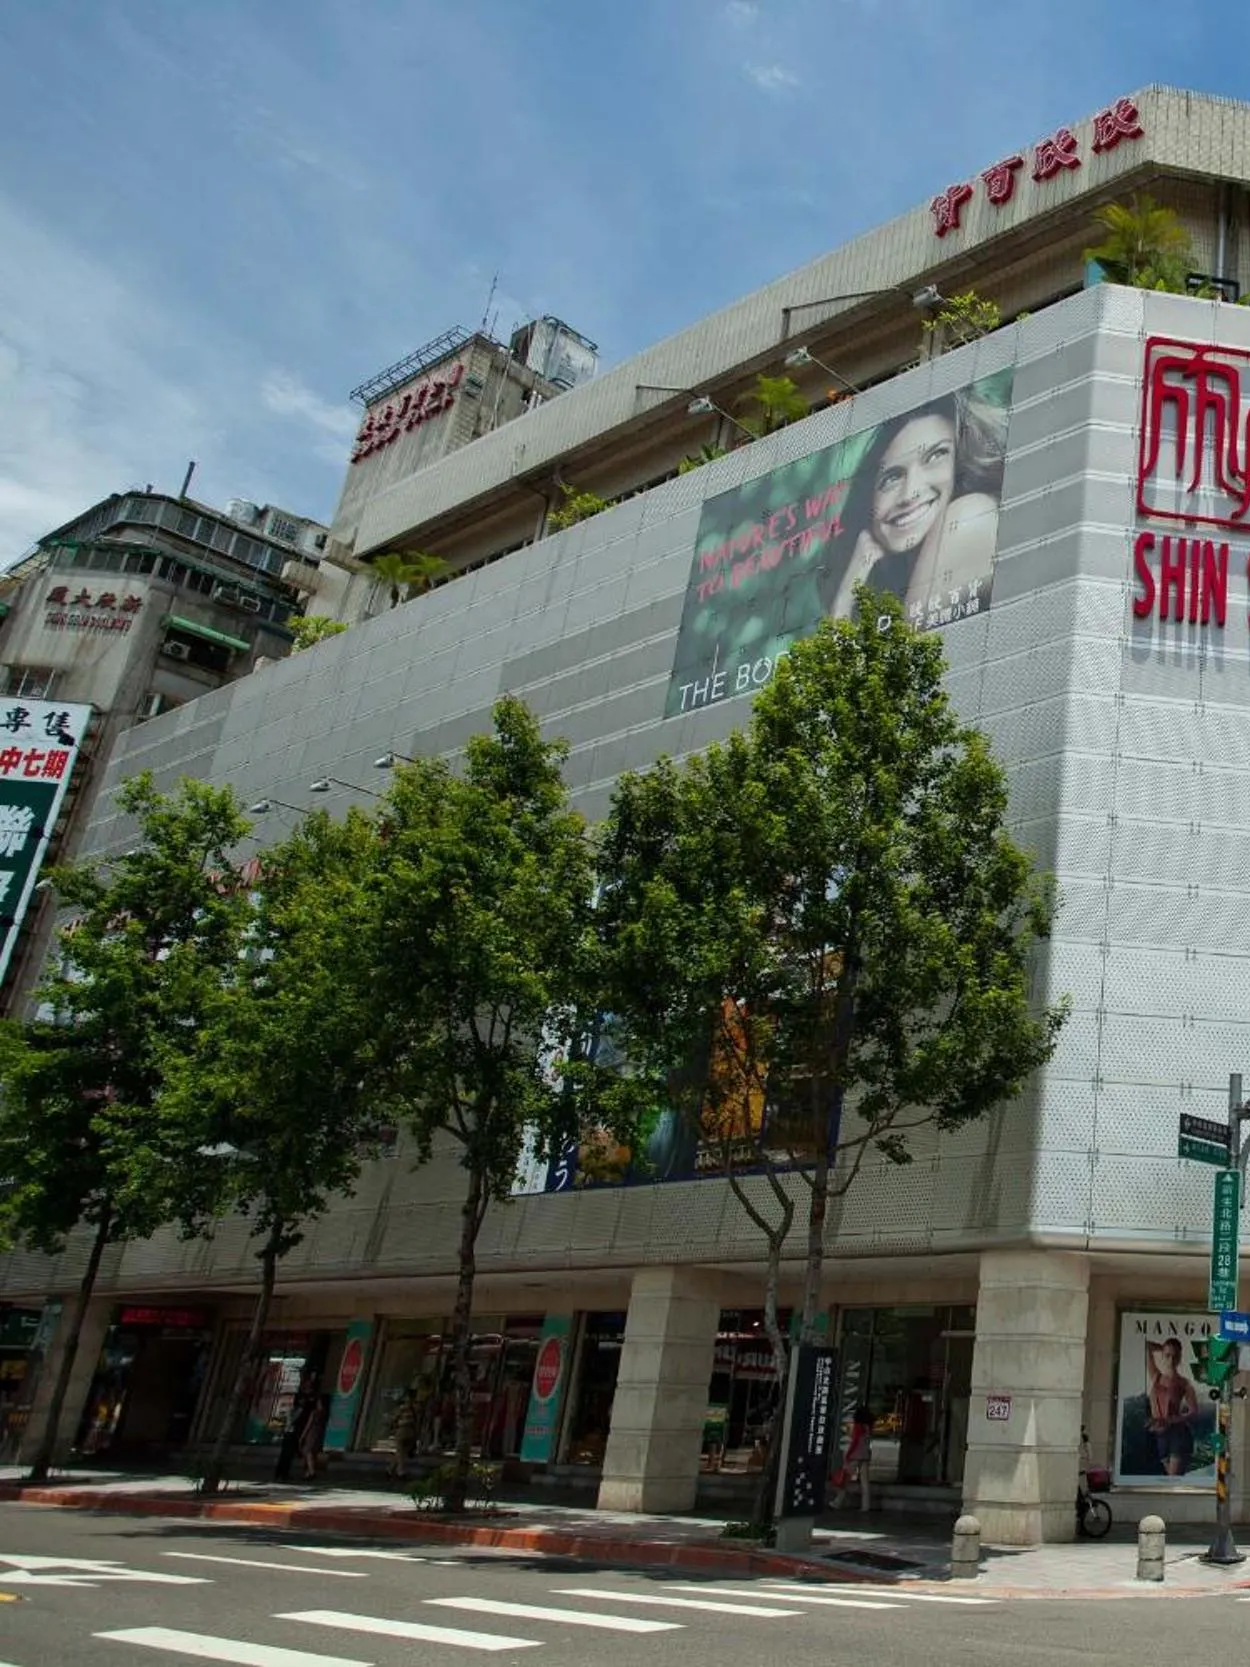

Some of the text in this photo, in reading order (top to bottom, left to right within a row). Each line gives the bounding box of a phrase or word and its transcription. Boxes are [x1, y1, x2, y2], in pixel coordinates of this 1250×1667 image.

[1133, 532, 1229, 627] SHIN
[679, 651, 790, 711] THE BO
[1135, 1318, 1211, 1336] MANGO
[988, 1405, 1007, 1416] 247
